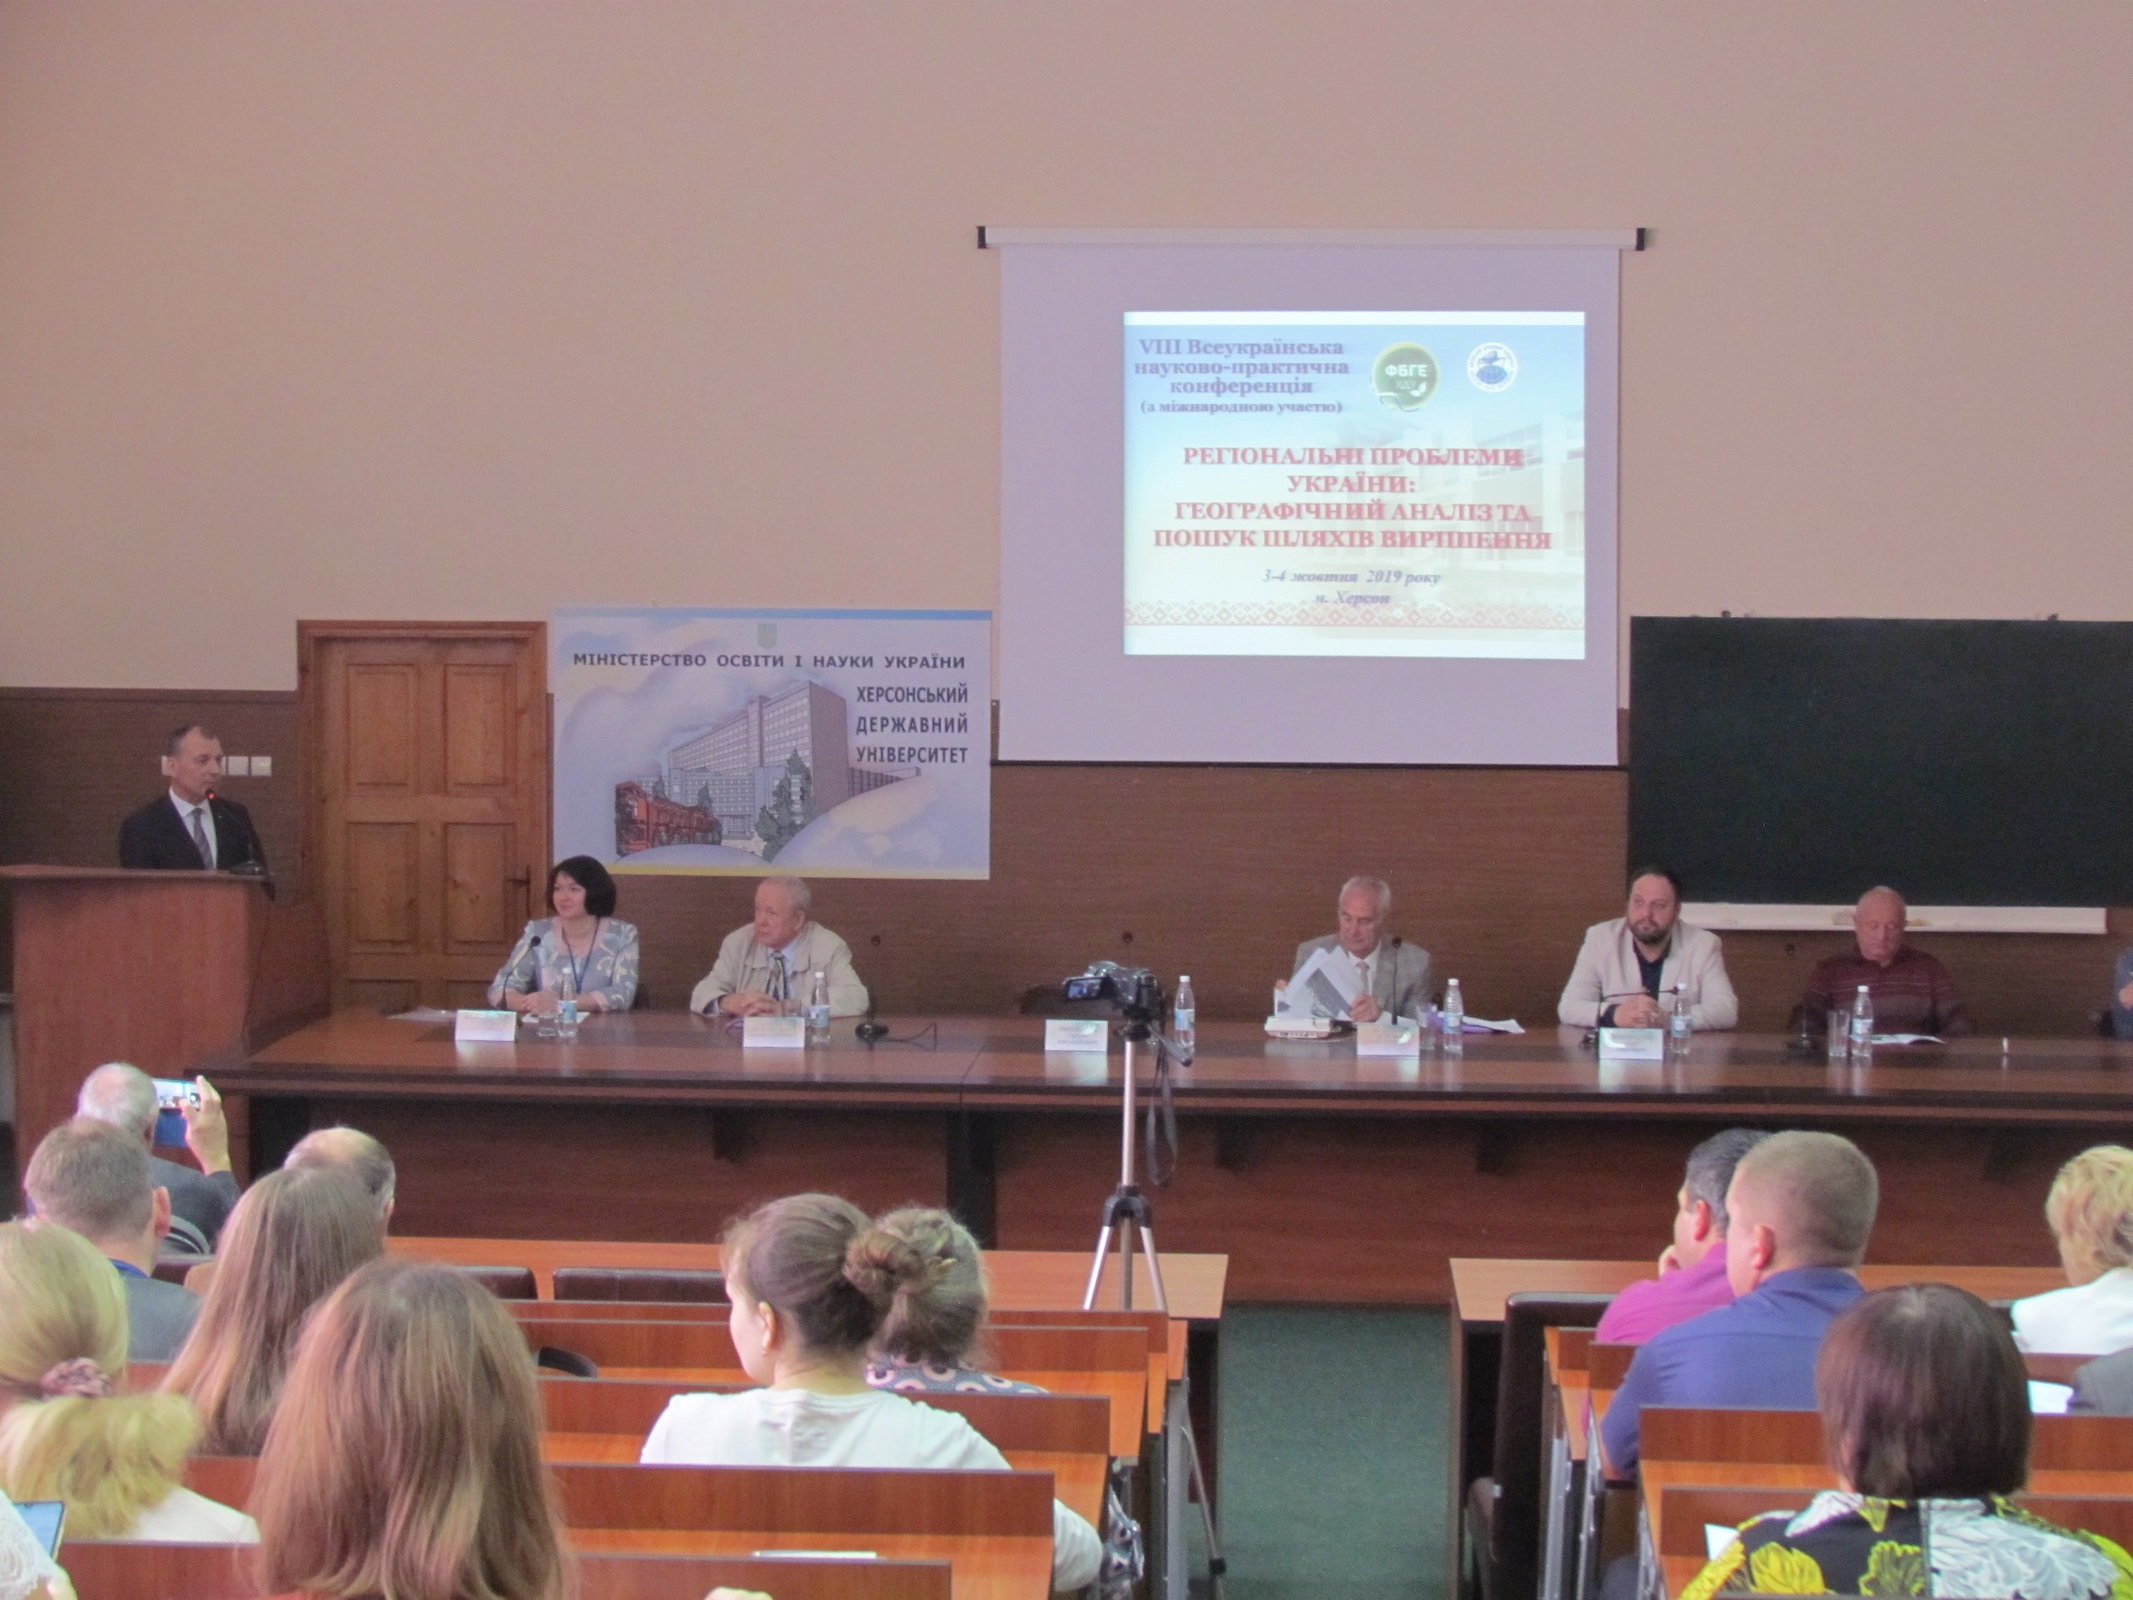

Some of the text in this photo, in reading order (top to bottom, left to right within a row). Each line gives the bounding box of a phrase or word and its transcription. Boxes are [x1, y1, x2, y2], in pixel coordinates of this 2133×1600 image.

[1139, 338, 1344, 358] VIII Всеукраїнська
[1134, 361, 1350, 378] науково-практична
[1384, 363, 1428, 378] ФБГЕ
[1170, 376, 1314, 397] конференція
[1159, 400, 1274, 415] міжнародною
[1277, 401, 1343, 415] участю)
[1182, 447, 1525, 467] РЕГІОНАЛЬНІ ПРОБЛЕМИ
[1286, 471, 1416, 493] УКРАЇНИ:
[1174, 498, 1533, 522] ГЕОГРАФІЧНИЙ АНАЛІЗ ТА
[1153, 529, 1552, 549] ПОШУК ШЛЯХІВ ВИРІШЕННЯ
[1365, 569, 1403, 583] 2019
[1403, 573, 1442, 587] року
[1333, 590, 1391, 606] Херсон
[573, 653, 965, 669] МІНІСТЕРСТВО ОСВІТИ І НАУКИ УКРАЇНИ
[856, 682, 968, 703] ХЕРСОНСЬКИЙ
[855, 713, 968, 735] ДЕРЖАВНИЙ
[856, 746, 968, 764] УНІВЕРСИТЕТ
